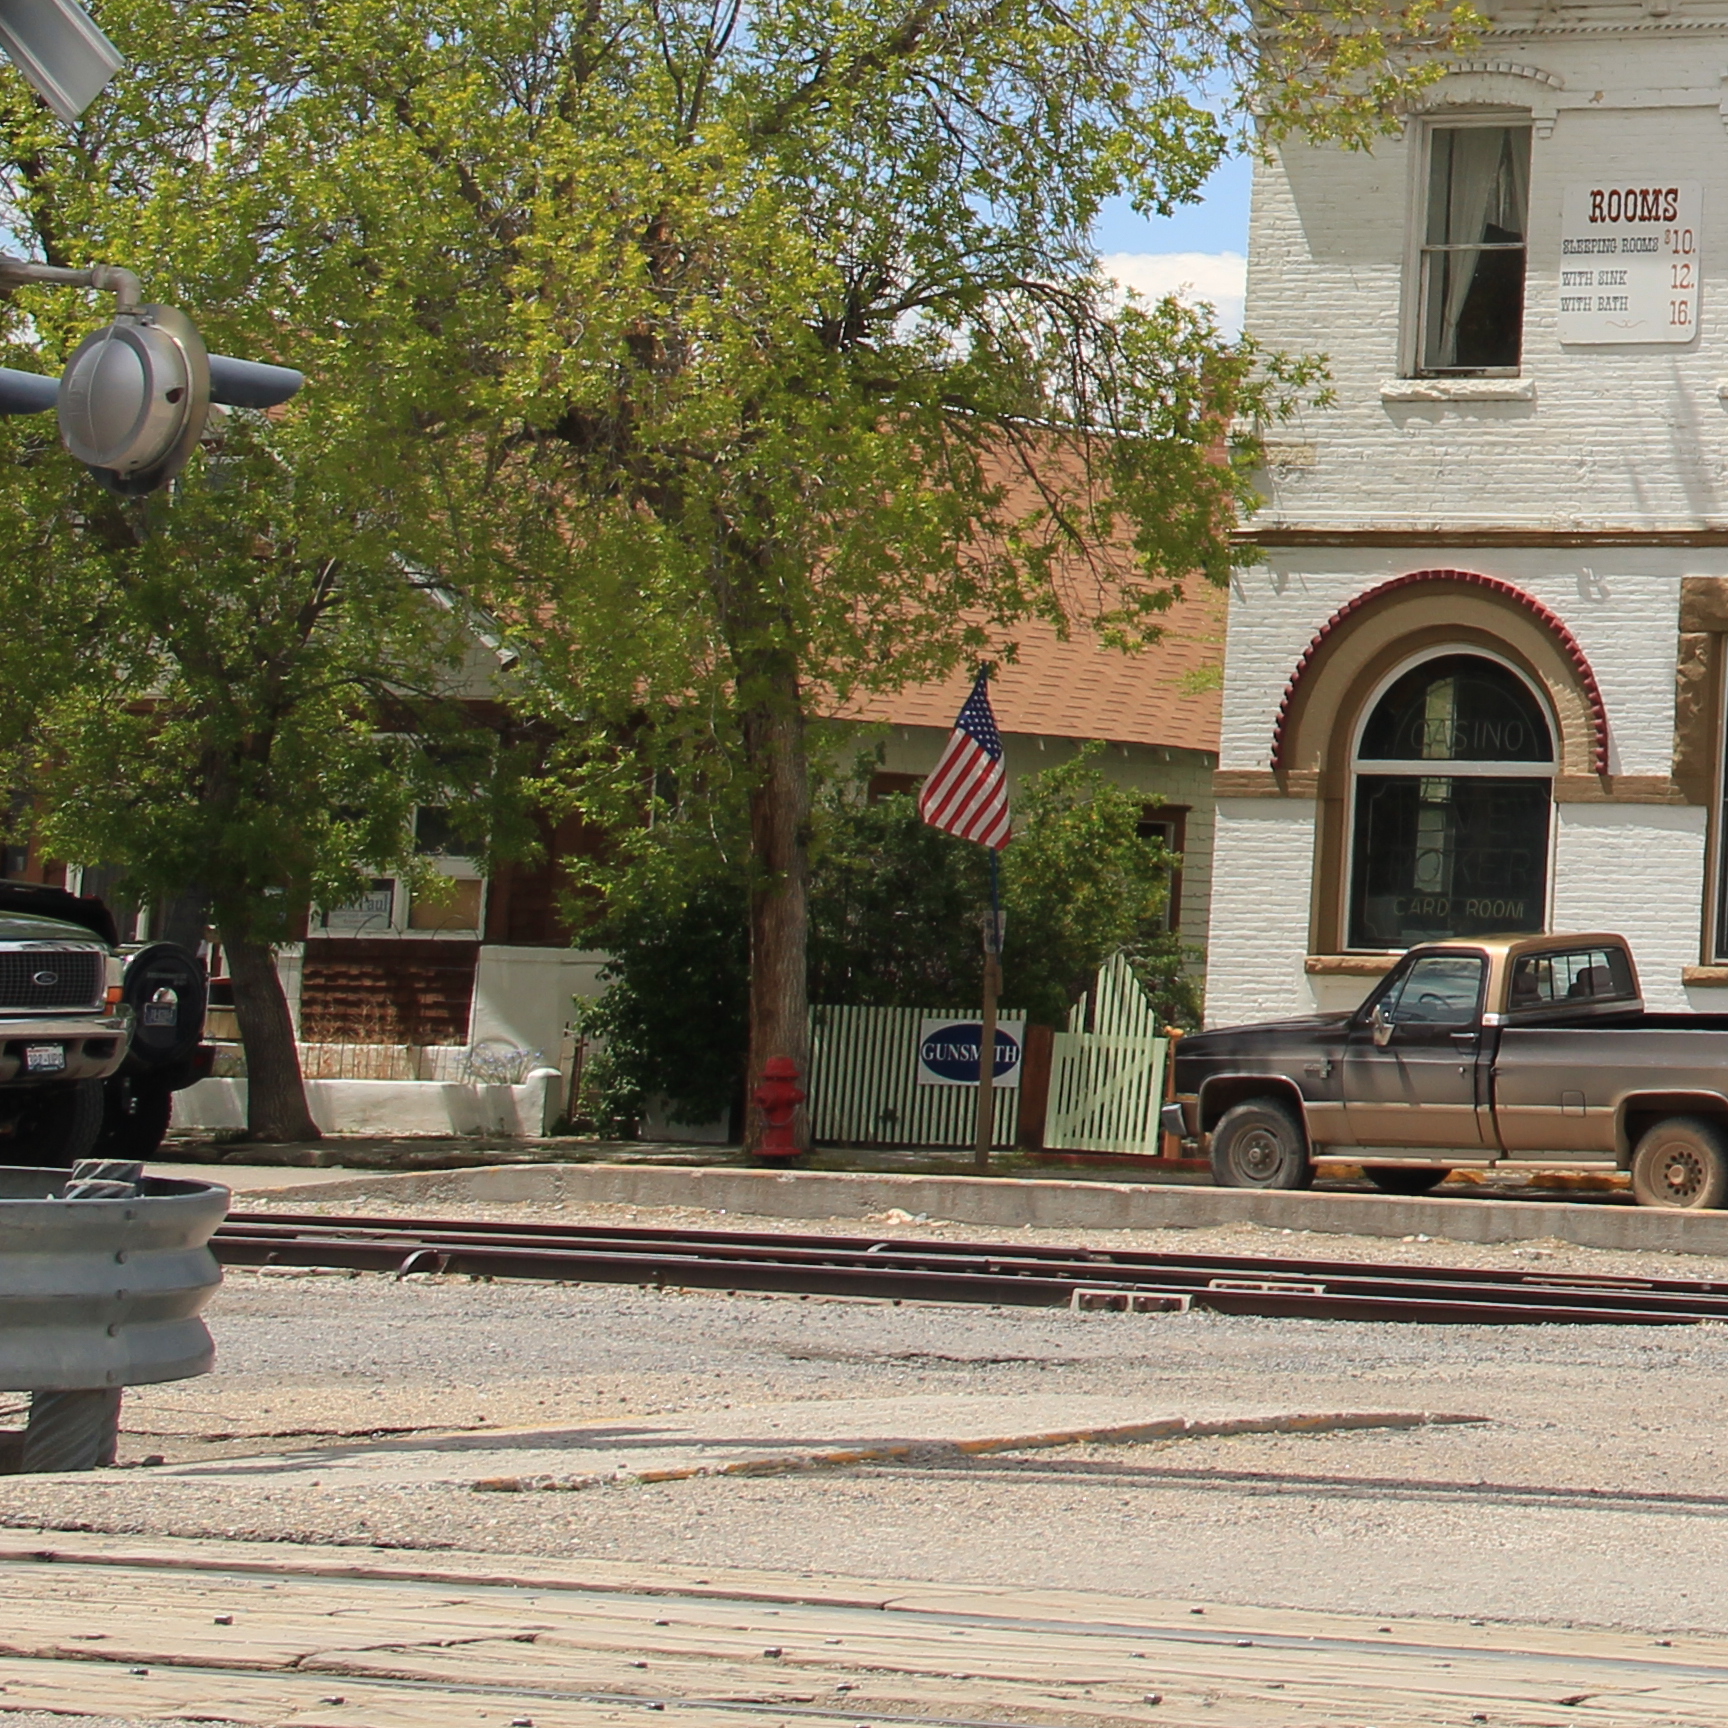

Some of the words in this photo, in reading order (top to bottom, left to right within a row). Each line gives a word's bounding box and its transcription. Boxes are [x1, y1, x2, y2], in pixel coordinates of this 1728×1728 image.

[1589, 187, 1680, 223] ROOMS
[1562, 237, 1619, 255] SLEEPING
[1621, 237, 1660, 254] ROOMS
[1562, 271, 1594, 287] WITH
[1598, 270, 1628, 286] SINK
[1671, 263, 1695, 290] 12.
[1561, 297, 1593, 313] WITH
[1597, 296, 1629, 312] BATH
[1669, 300, 1692, 326] 16.
[1410, 718, 1522, 752] CASINO
[1393, 898, 1450, 918] CARD
[1465, 899, 1525, 920] ROOM
[921, 1043, 1018, 1063] GUNSMTH
